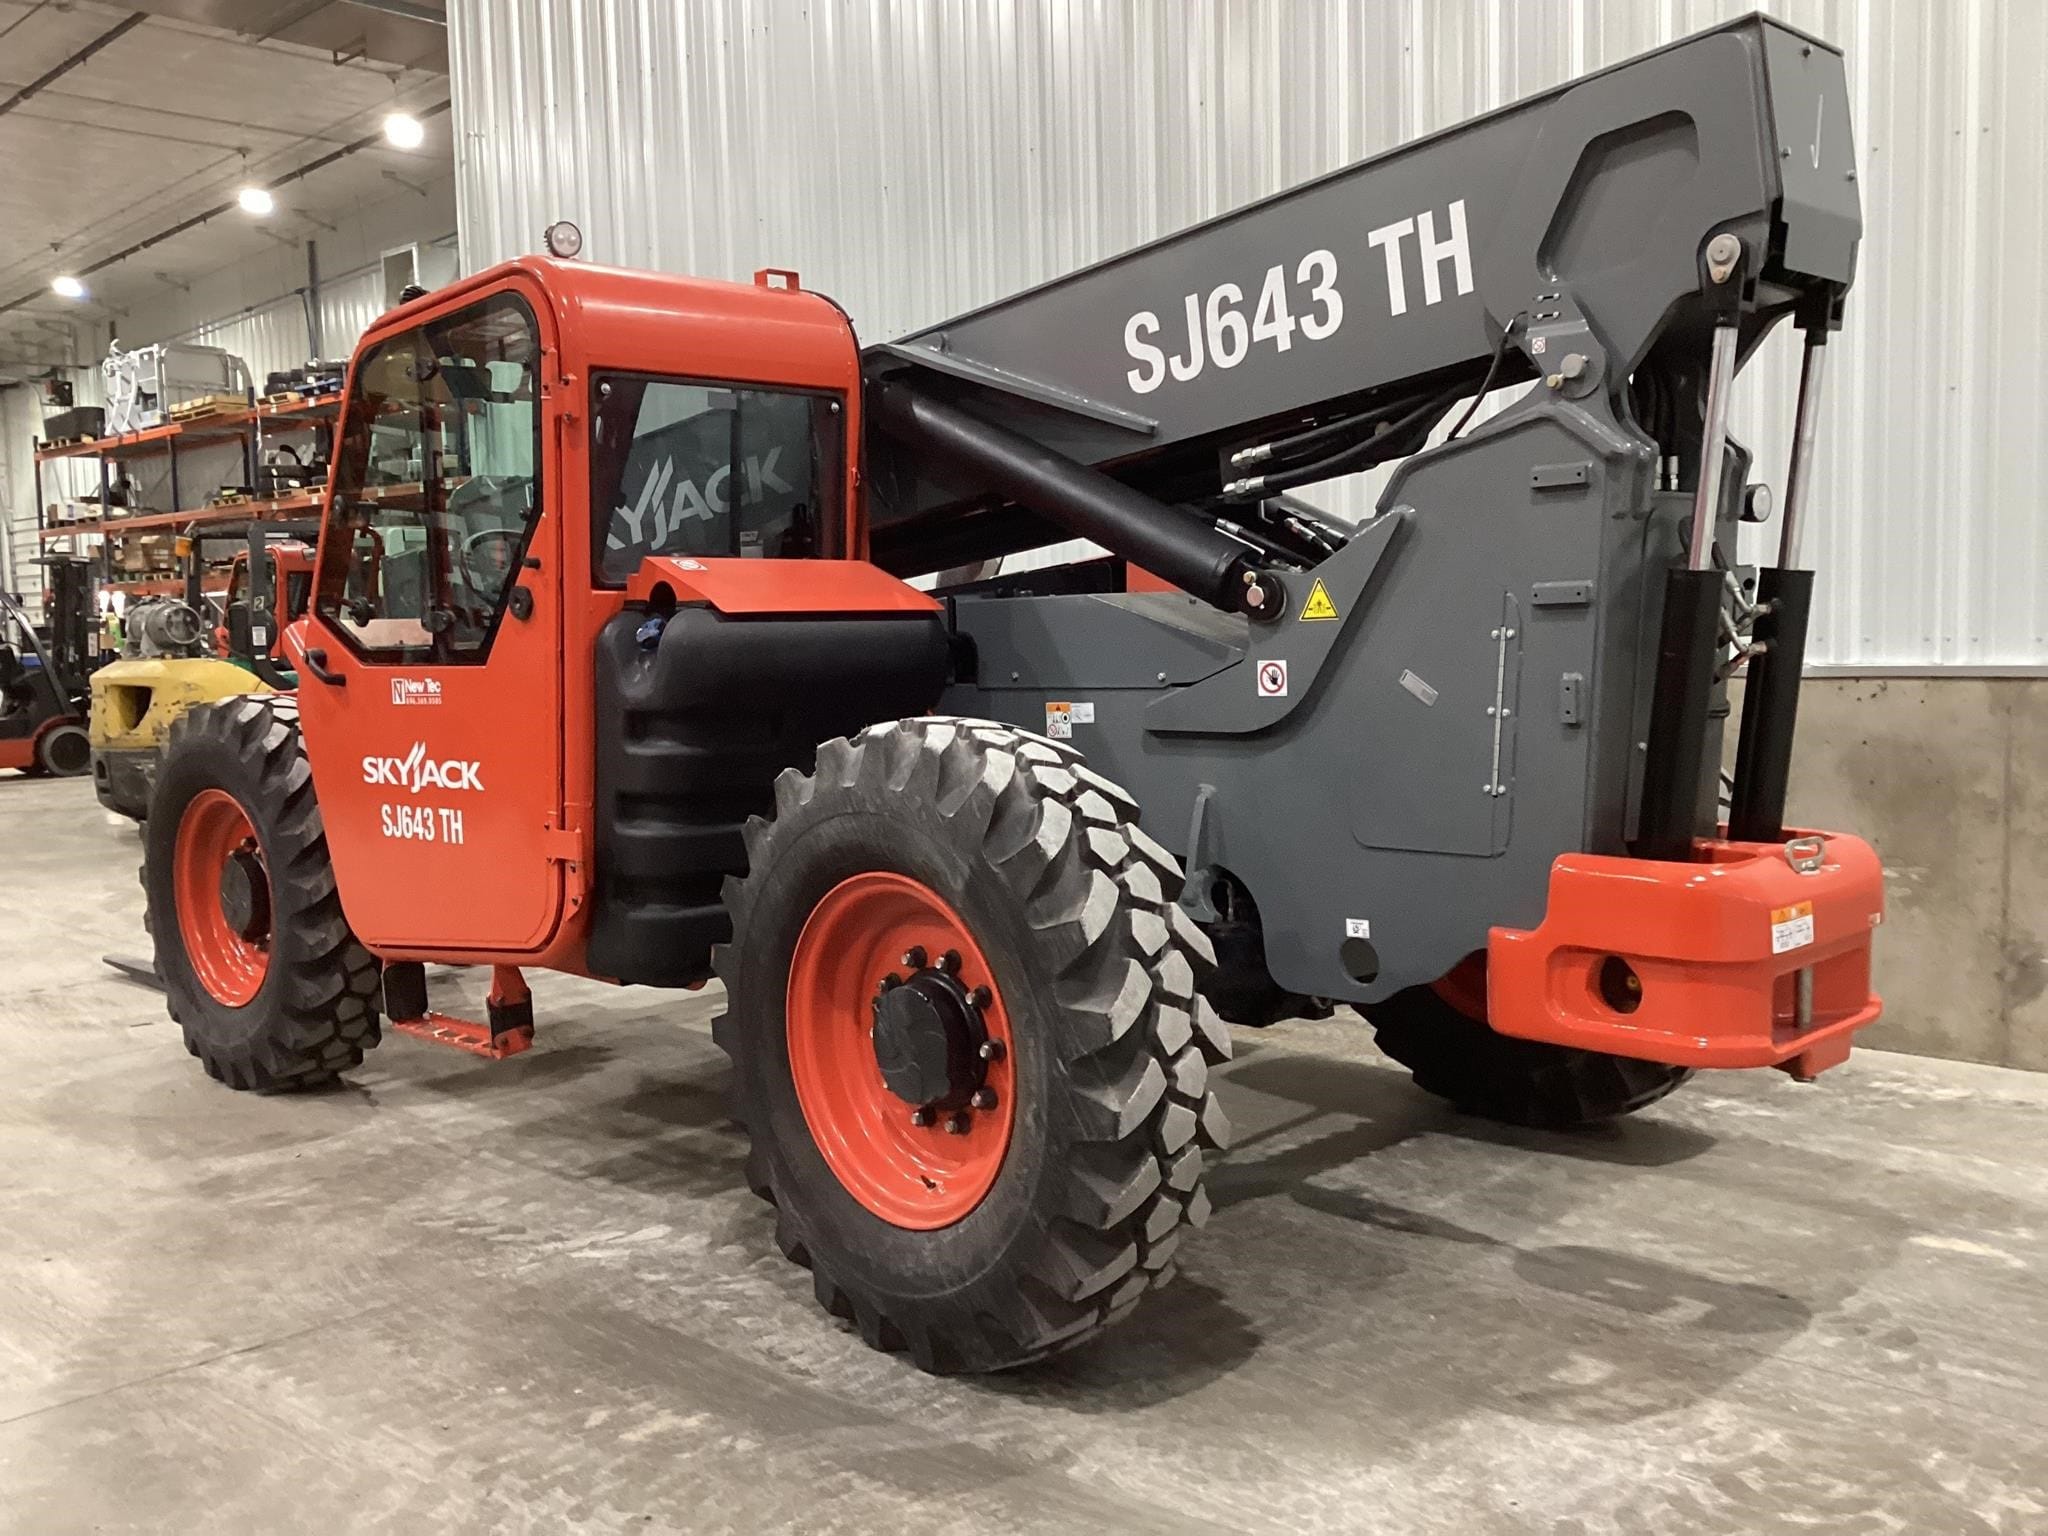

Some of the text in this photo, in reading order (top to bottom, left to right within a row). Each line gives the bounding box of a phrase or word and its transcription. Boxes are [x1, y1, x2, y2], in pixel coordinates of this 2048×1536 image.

[1124, 199, 1474, 394] SJ643 TH
[606, 446, 794, 551] YJACK
[405, 678, 441, 693] New Tec
[362, 741, 485, 793] SKYJACK
[381, 804, 464, 844] SJ643 TH
